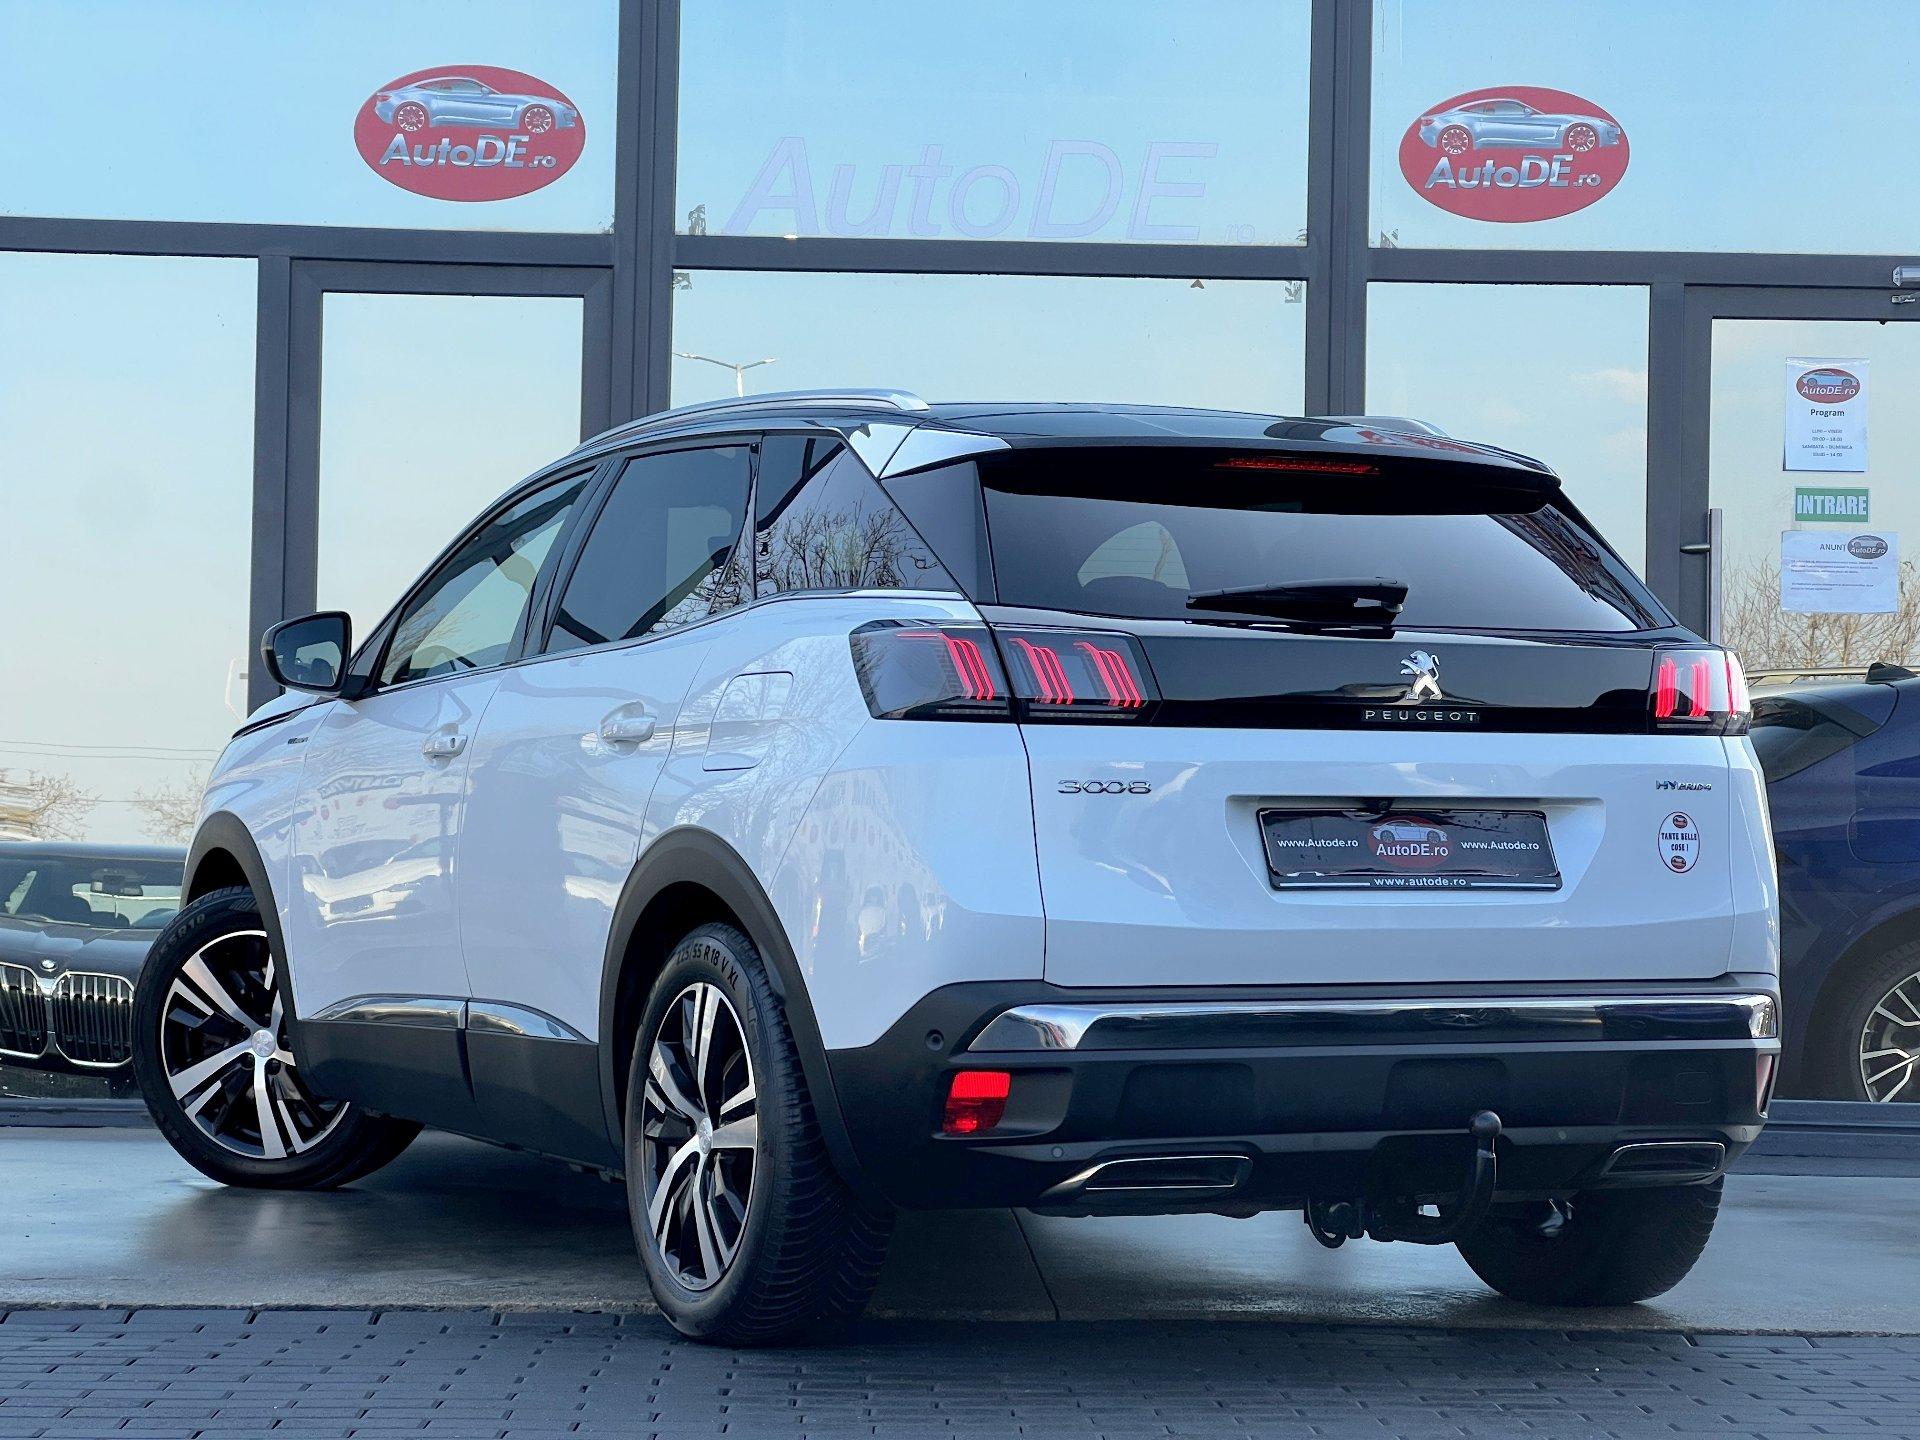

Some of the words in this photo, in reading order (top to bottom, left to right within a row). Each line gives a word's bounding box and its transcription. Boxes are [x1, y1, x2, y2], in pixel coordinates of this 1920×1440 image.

[722, 136, 1219, 241] AutoDE
[1801, 386, 1856, 395] AutoDE.ro
[1810, 408, 1845, 418] Program
[1796, 494, 1867, 515] INTRARE
[1365, 709, 1478, 723] PEUGEOT
[1057, 779, 1152, 794] 3008
[1661, 832, 1680, 840] TANTE
[1680, 832, 1697, 841] BELLE
[1277, 838, 1359, 849] www.Autode.ro
[1461, 840, 1540, 851] www.Autode.ro
[1671, 843, 1685, 851] COSE
[1376, 843, 1449, 857] AutoDE.ro
[1373, 876, 1467, 888] www.autode.ro
